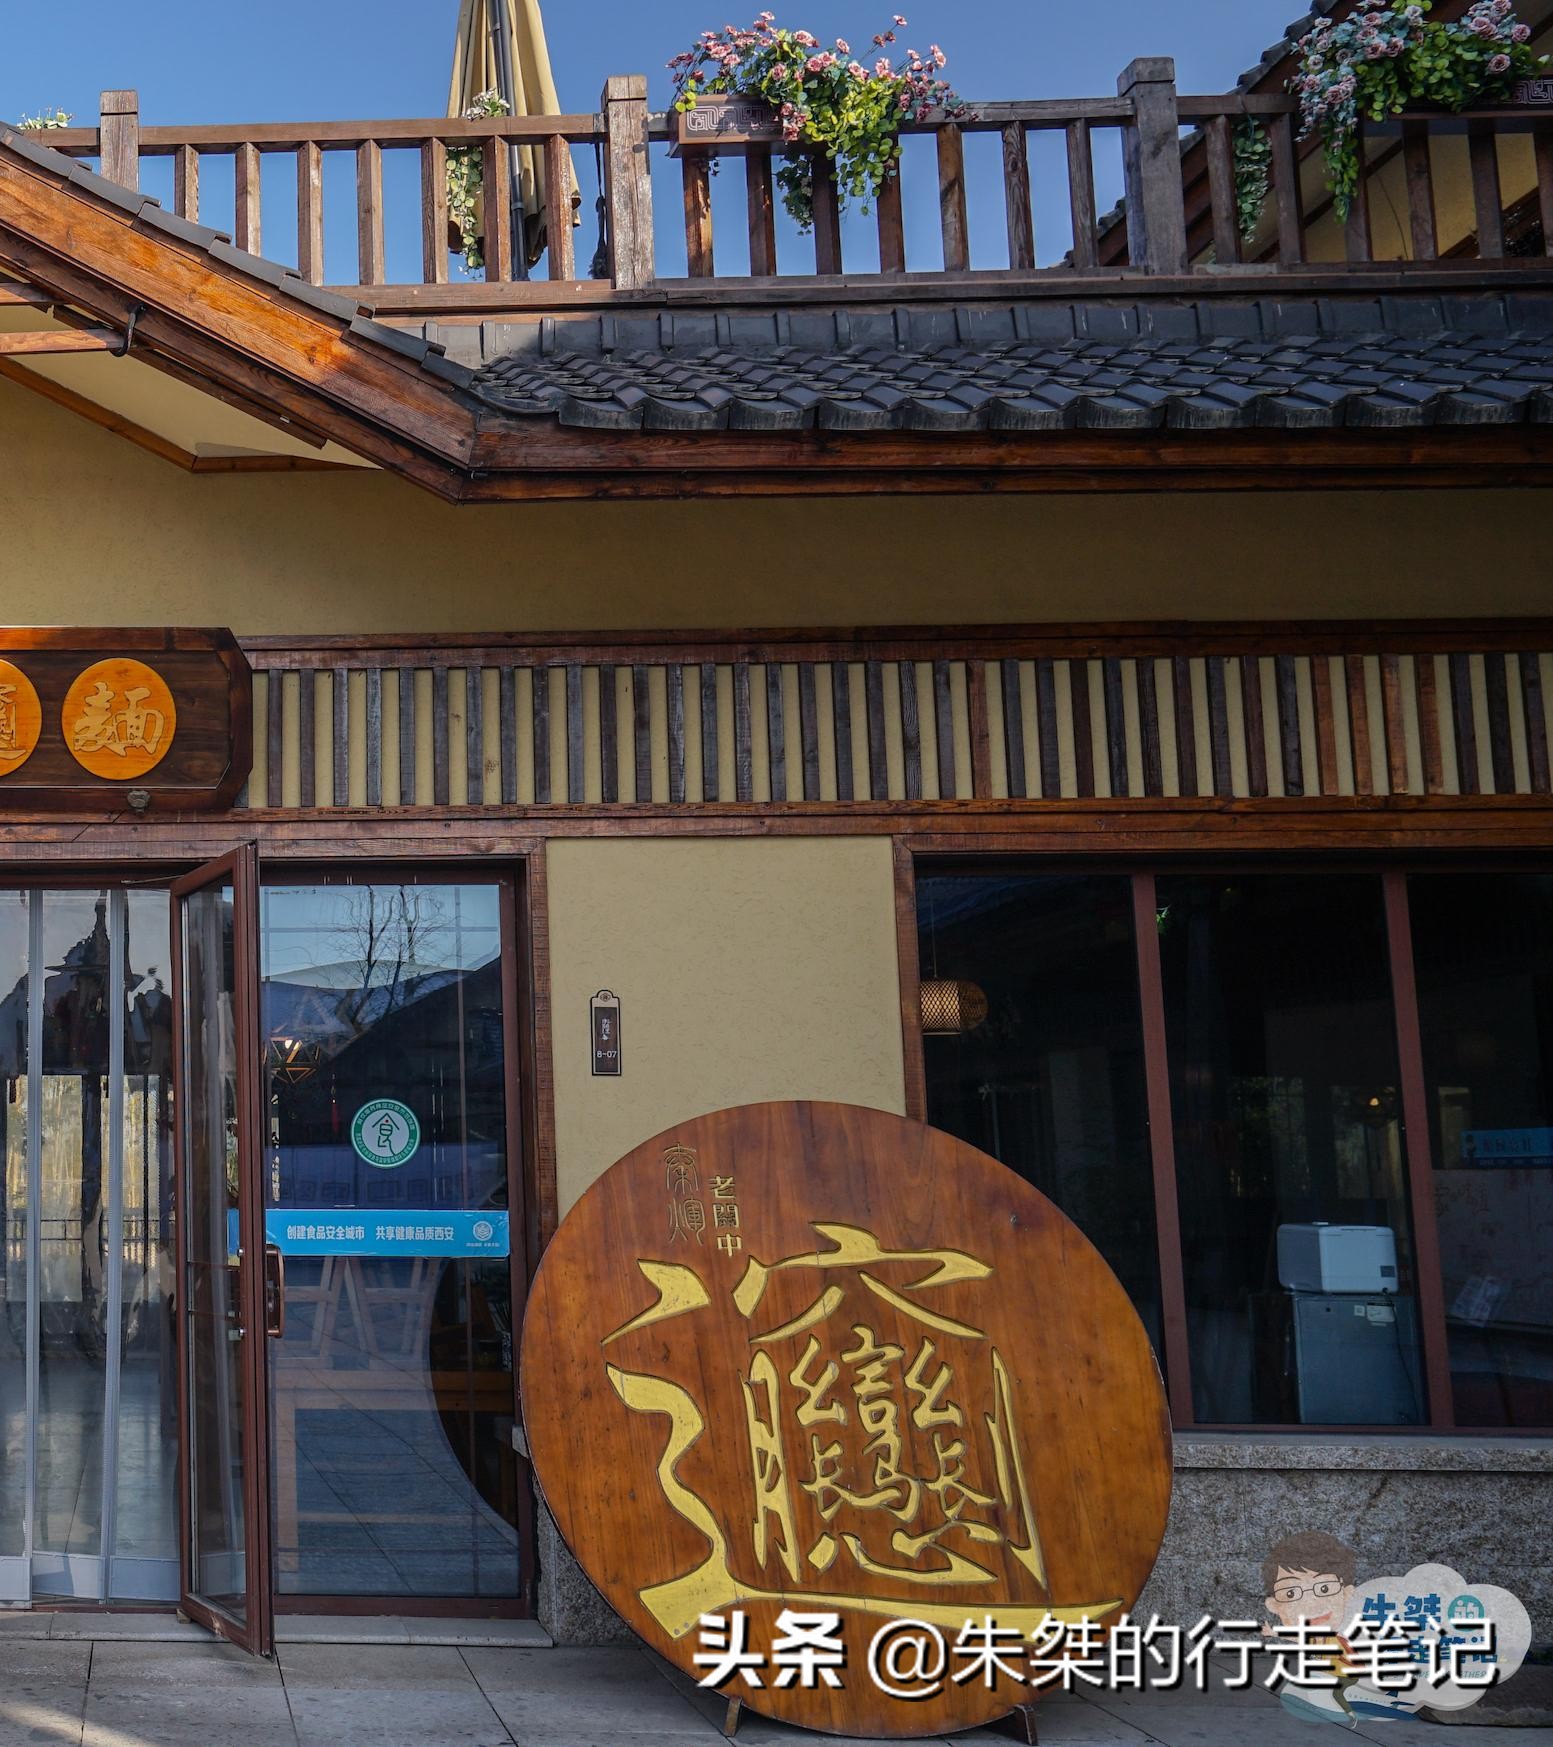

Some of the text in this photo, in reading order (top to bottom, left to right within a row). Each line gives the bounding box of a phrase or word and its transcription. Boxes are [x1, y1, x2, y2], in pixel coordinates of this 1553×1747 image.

[596, 1050, 618, 1058] 8-07
[287, 1225, 454, 1241] 创建食品安全城市 共享健康品质西安
